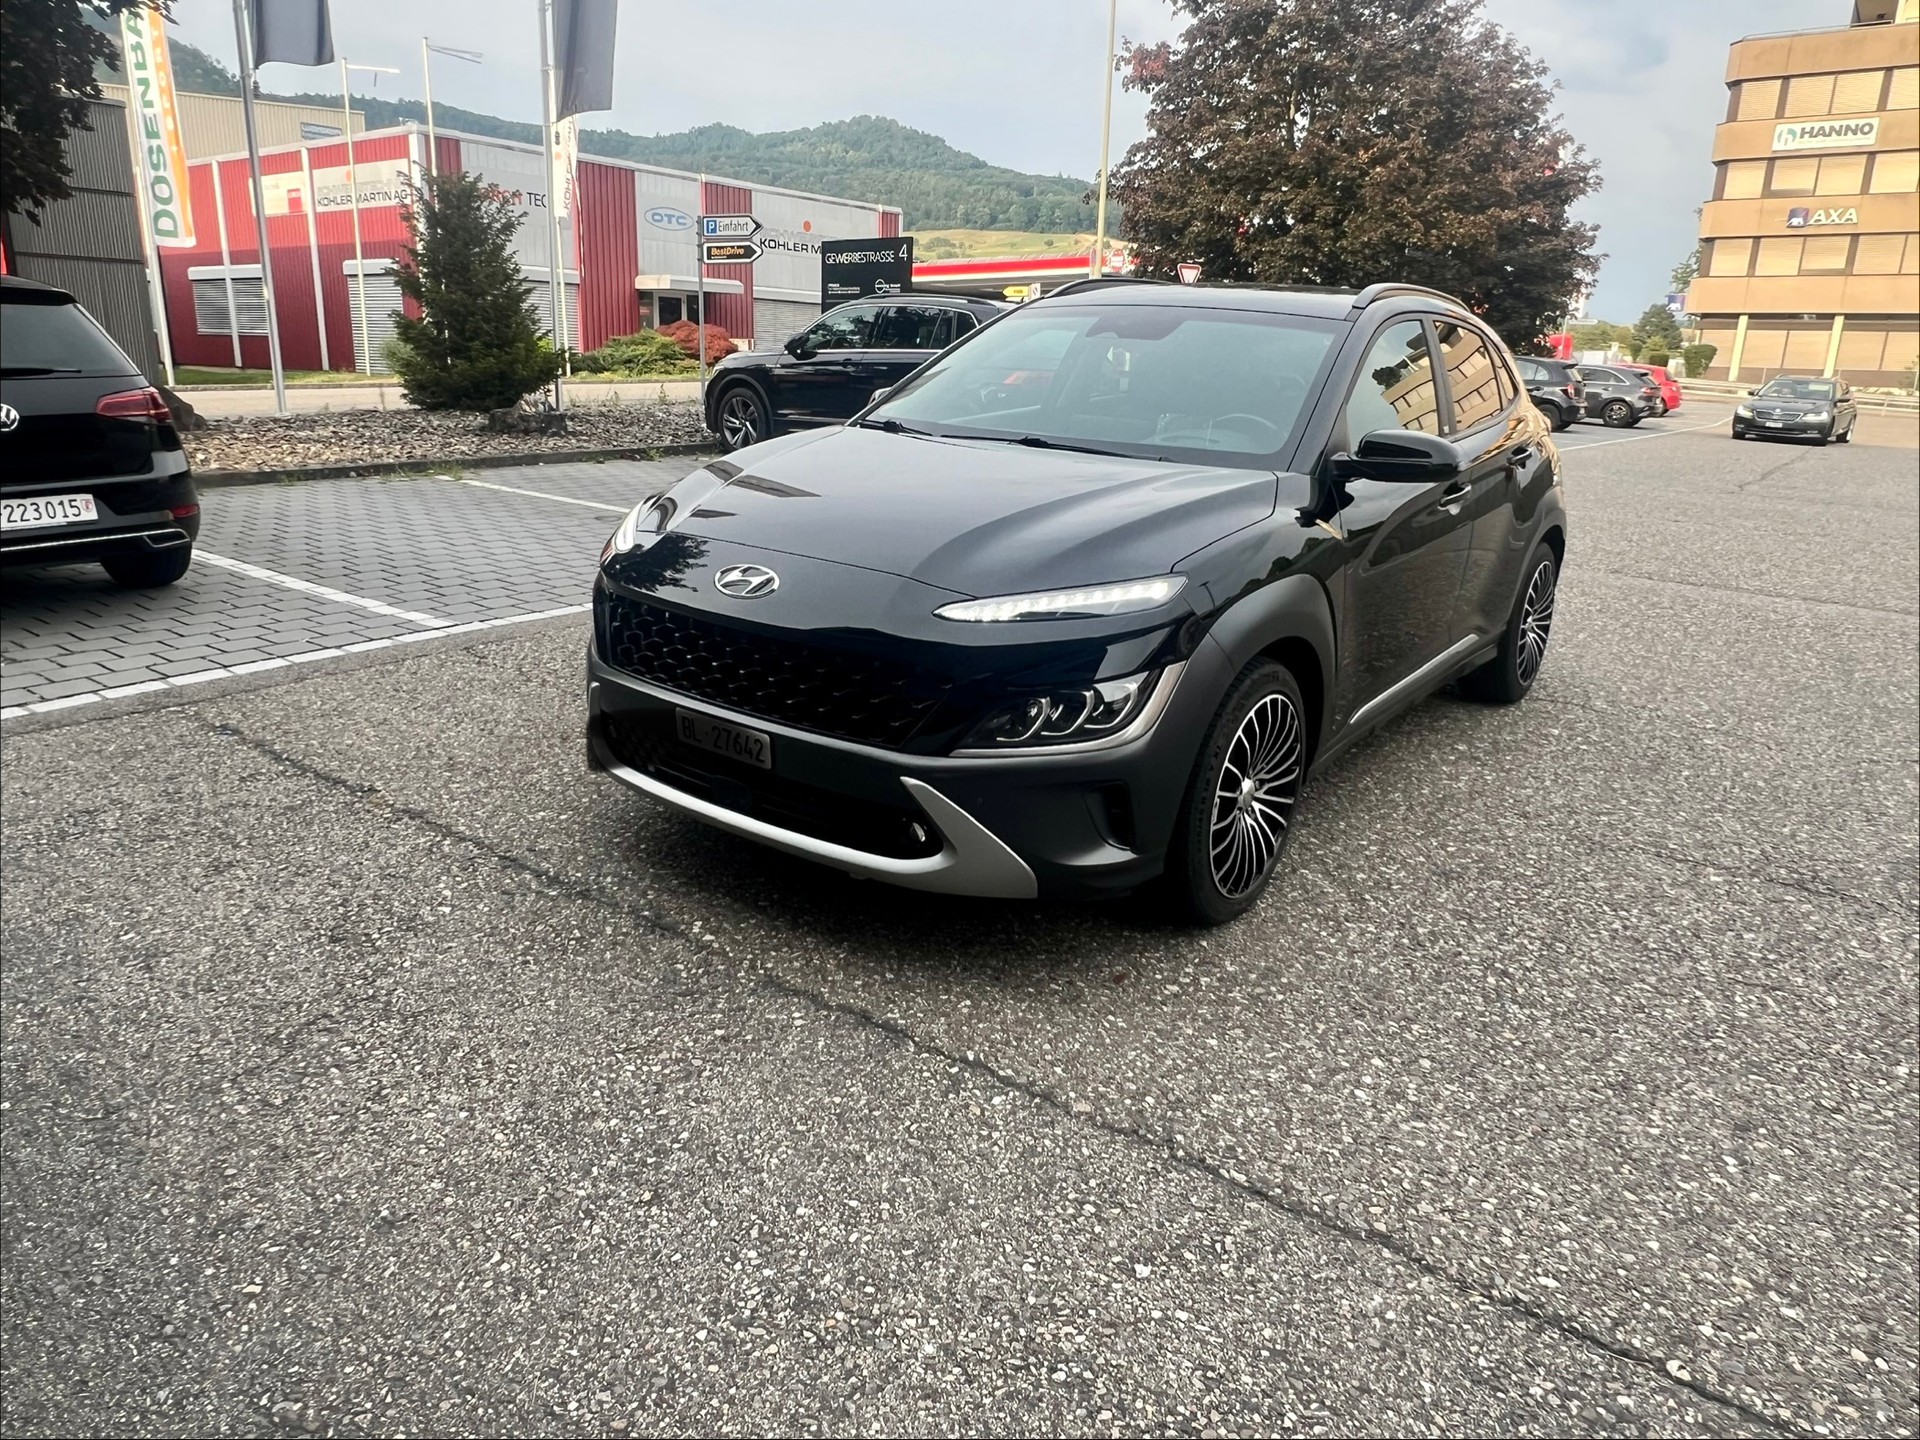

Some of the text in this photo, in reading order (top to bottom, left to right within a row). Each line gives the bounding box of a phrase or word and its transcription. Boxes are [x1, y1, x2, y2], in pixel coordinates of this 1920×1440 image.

[1799, 122, 1874, 139] HANNO
[317, 194, 353, 207] KOHLER
[354, 190, 393, 204] MARTIN
[393, 189, 408, 200] AG
[651, 212, 688, 226] OTC
[1807, 207, 1858, 225] AXA
[718, 219, 749, 233] Einfahrt
[760, 238, 808, 253] KOHLER
[825, 243, 908, 264] GEWERBESTRASSE 4
[711, 724, 766, 764] 27642
